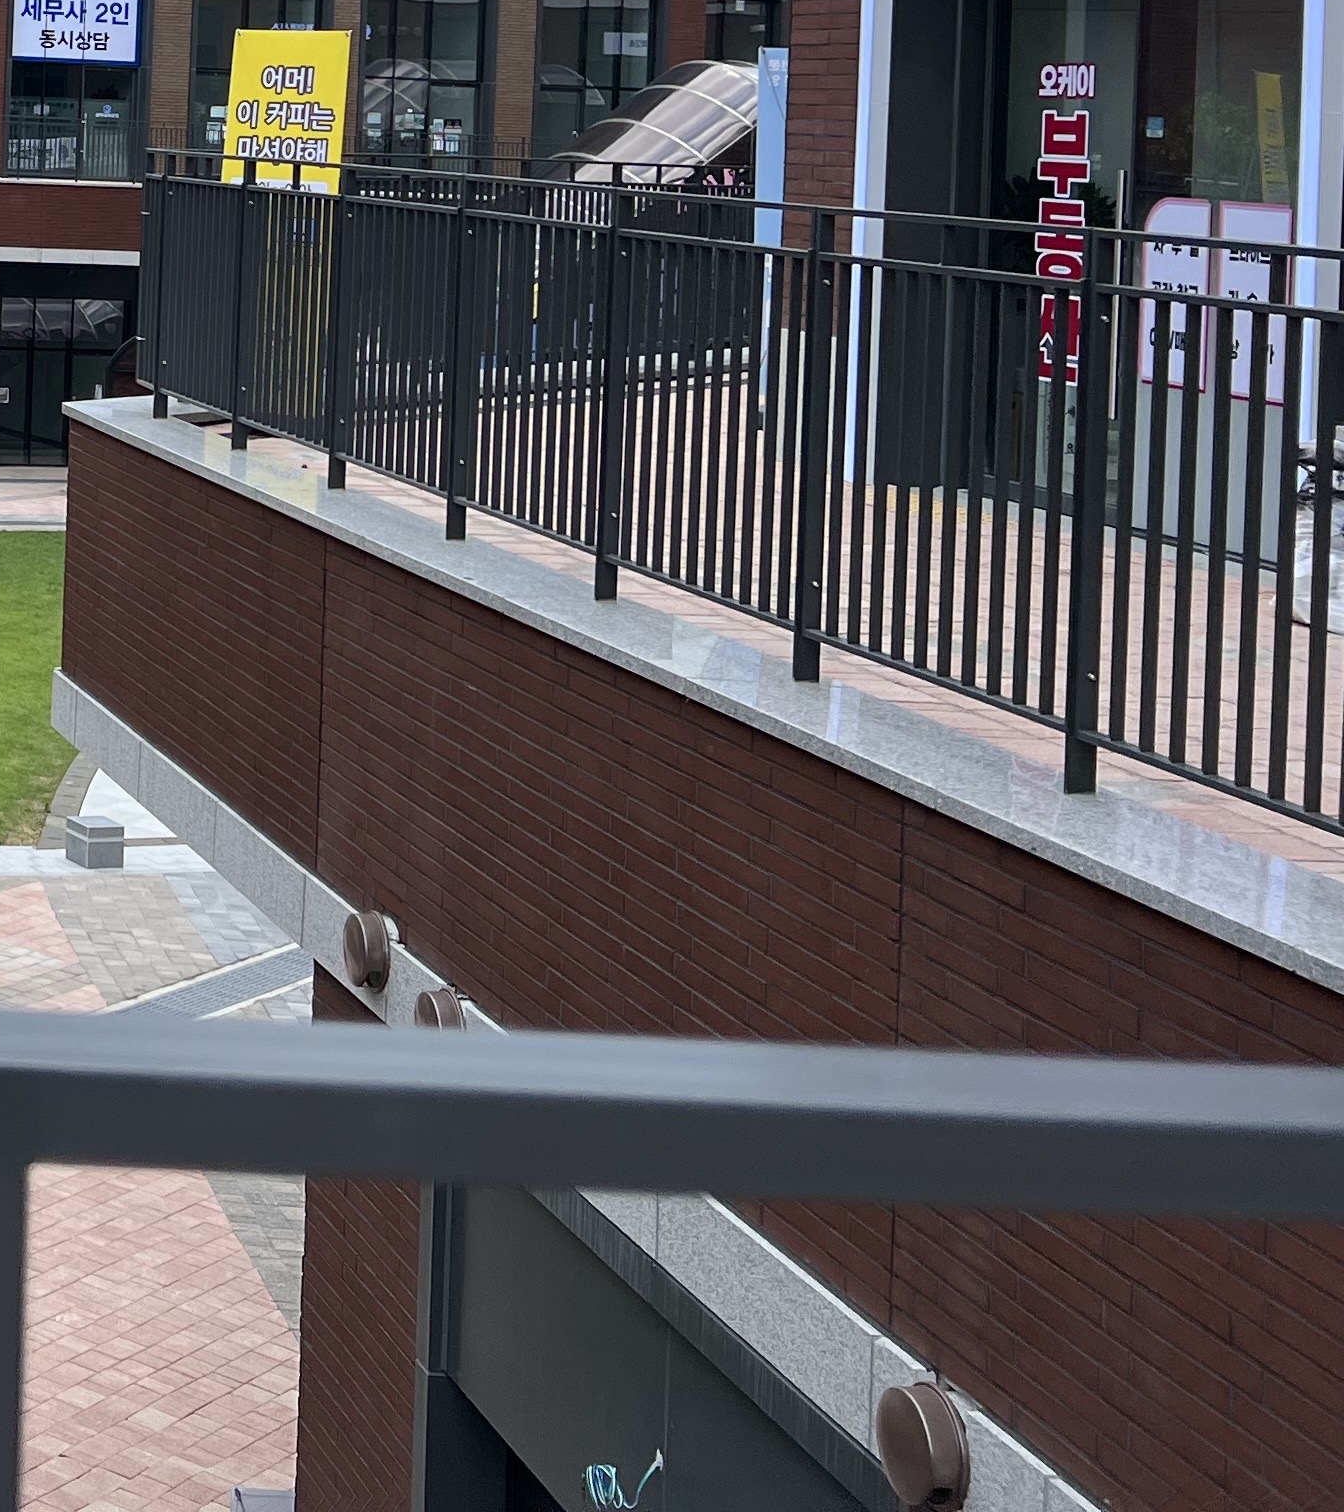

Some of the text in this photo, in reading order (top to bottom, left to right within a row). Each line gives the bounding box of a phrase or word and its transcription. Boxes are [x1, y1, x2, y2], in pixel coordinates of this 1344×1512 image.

[95, 2, 130, 26] 2인
[38, 29, 111, 51] 동시상담
[261, 65, 316, 96] 어머!
[1037, 63, 1096, 98] 오케이
[236, 100, 336, 133] 이 커피는
